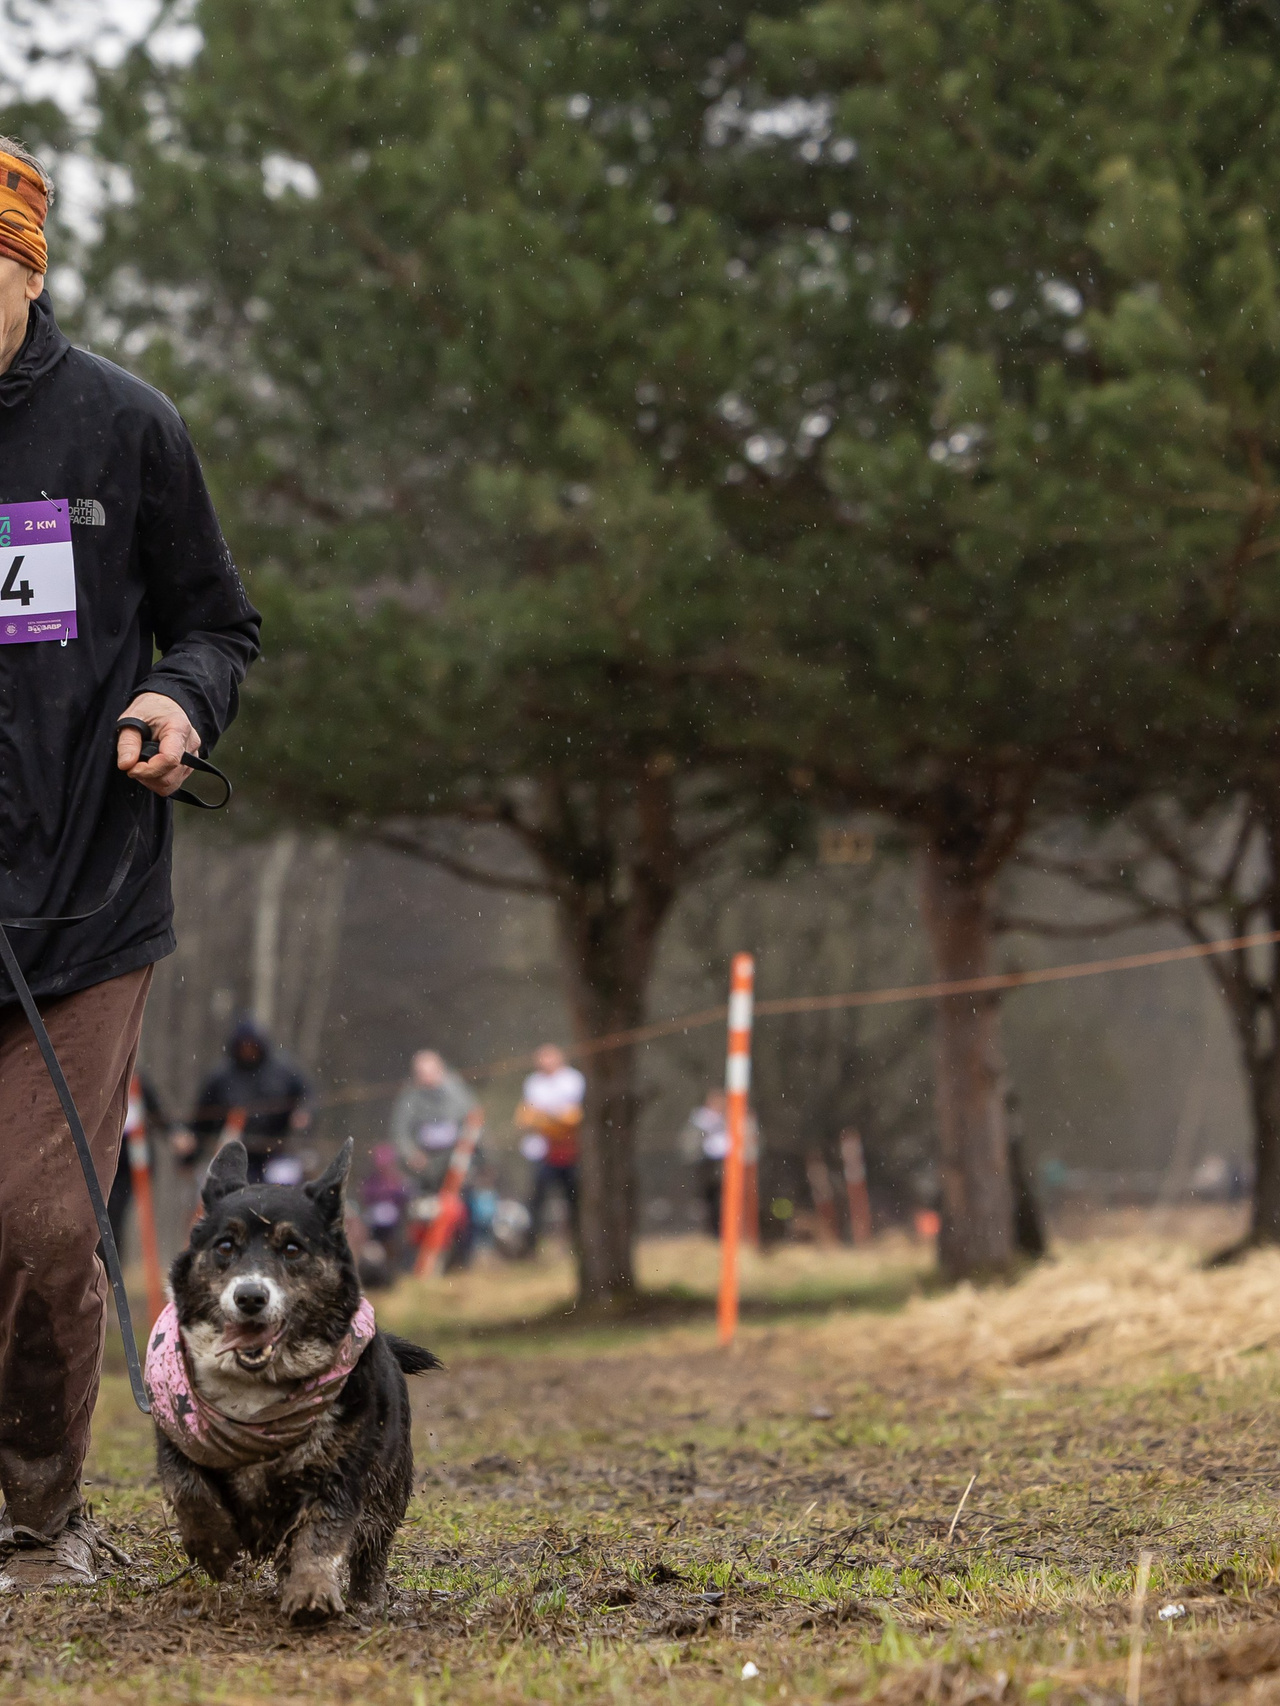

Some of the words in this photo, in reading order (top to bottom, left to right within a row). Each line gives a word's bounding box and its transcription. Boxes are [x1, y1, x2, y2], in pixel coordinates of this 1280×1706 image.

[76, 498, 93, 508] THE
[68, 507, 93, 517] ORTH
[24, 520, 34, 531] 2
[70, 516, 92, 526] FACE
